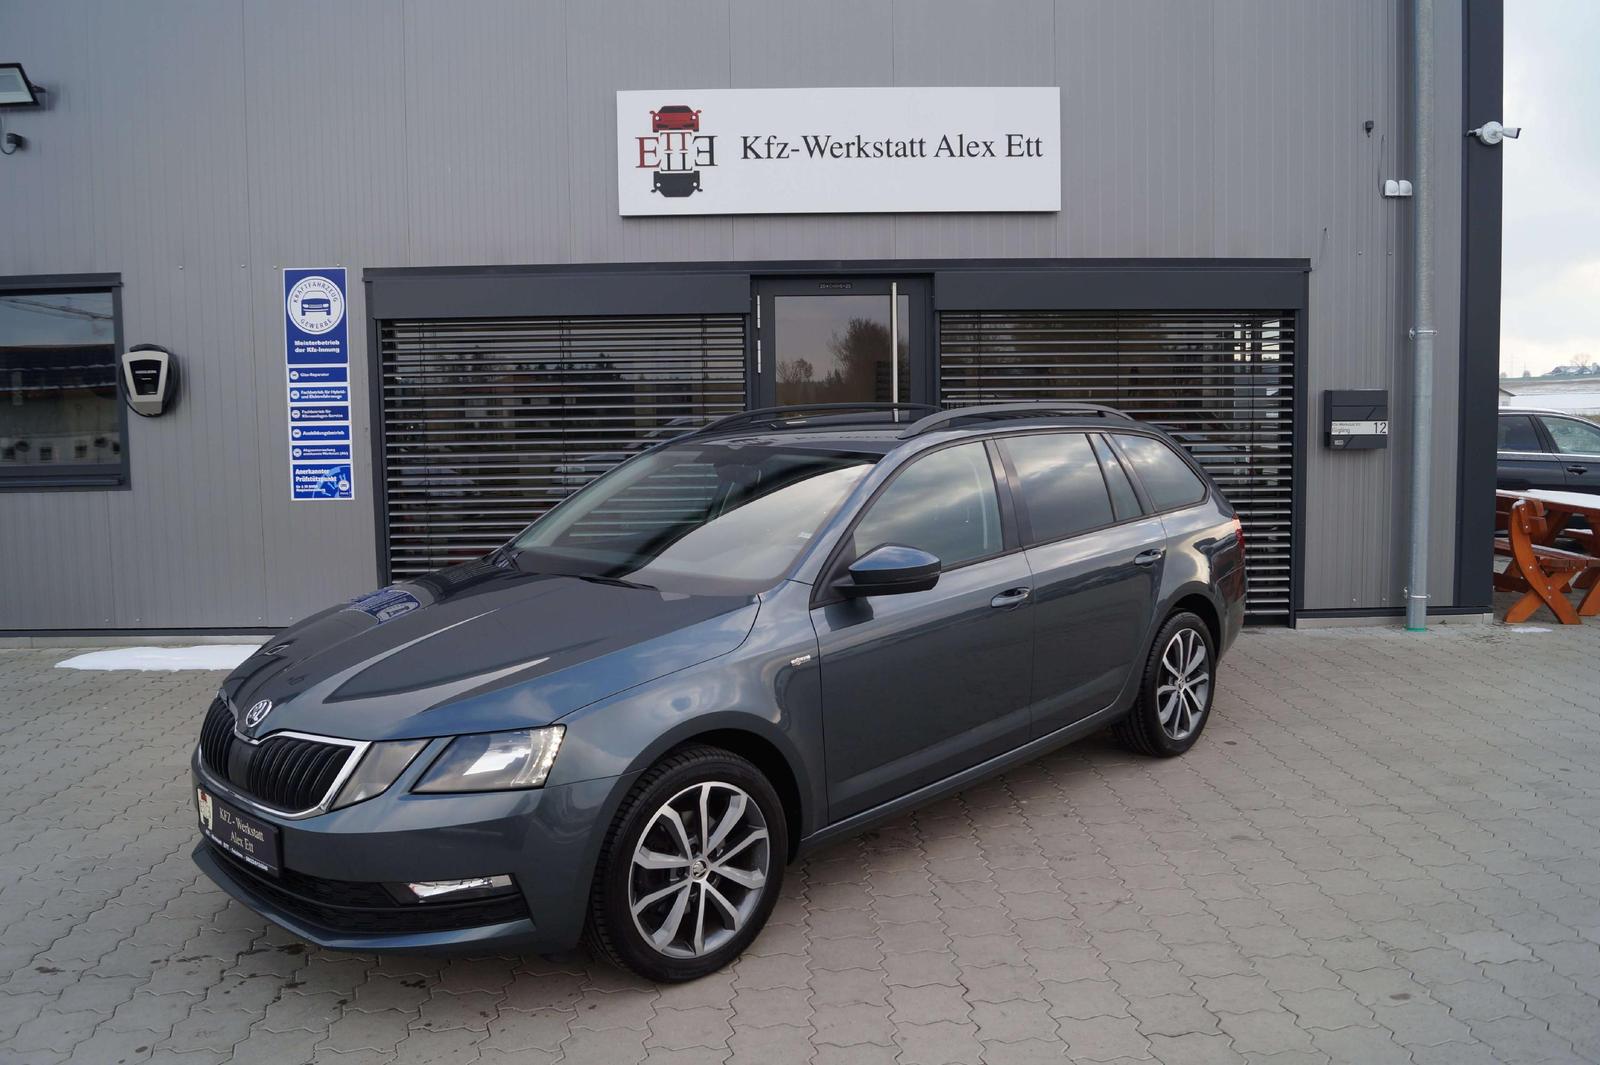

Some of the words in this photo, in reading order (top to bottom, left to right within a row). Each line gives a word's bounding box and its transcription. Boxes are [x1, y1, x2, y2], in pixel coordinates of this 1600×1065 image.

[740, 134, 927, 160] Kfz-Werkstatt
[933, 133, 996, 159] Alex
[1004, 133, 1044, 158] Ett
[300, 318, 333, 330] GEWERBE
[1374, 422, 1387, 434] 12
[219, 807, 232, 825] KFZ
[235, 817, 265, 842] Werkstatt
[231, 831, 244, 848] Alex
